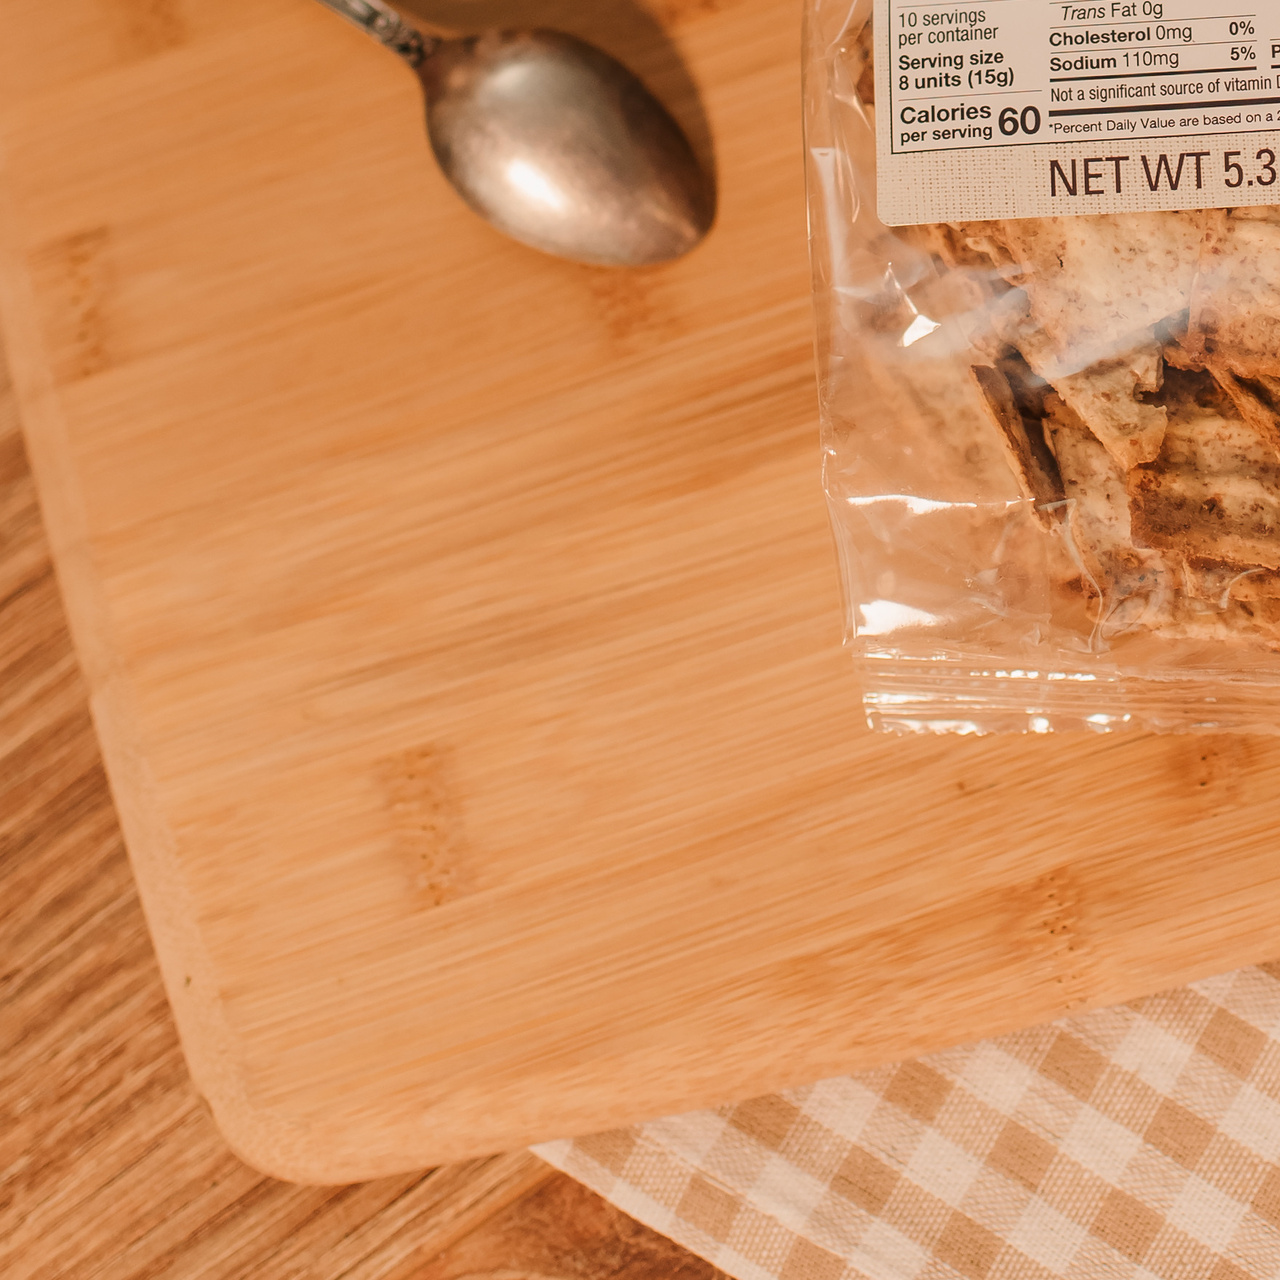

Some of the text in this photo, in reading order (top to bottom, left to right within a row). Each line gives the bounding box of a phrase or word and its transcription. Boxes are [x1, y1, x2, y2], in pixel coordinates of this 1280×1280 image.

[899, 9, 986, 28] 10 servings
[1061, 0, 1163, 21] Trans Fat 0g
[899, 25, 999, 49] per container
[1049, 21, 1255, 47] Cholesterol 0mg 0%
[899, 50, 1004, 73] Serving size
[1049, 46, 1256, 72] Sodium 110mg 5%
[899, 68, 1014, 91] 8 units (15g)
[1051, 87, 1073, 102] Not
[1077, 90, 1086, 100] a
[1090, 81, 1156, 101] significant
[1159, 81, 1204, 98] source
[1208, 79, 1221, 94] of
[1224, 76, 1272, 92] vitamin
[900, 102, 992, 125] Calories
[999, 105, 1041, 136] 60
[1106, 116, 1136, 133] Daily
[1140, 114, 1175, 129] Value
[1179, 115, 1199, 126] are
[1203, 111, 1242, 126] based
[1246, 112, 1261, 123] on
[1266, 112, 1272, 122] a
[900, 123, 993, 146] per serving
[1049, 156, 1129, 197] NET
[1141, 152, 1210, 192] WT
[1223, 148, 1277, 189] 5.3
